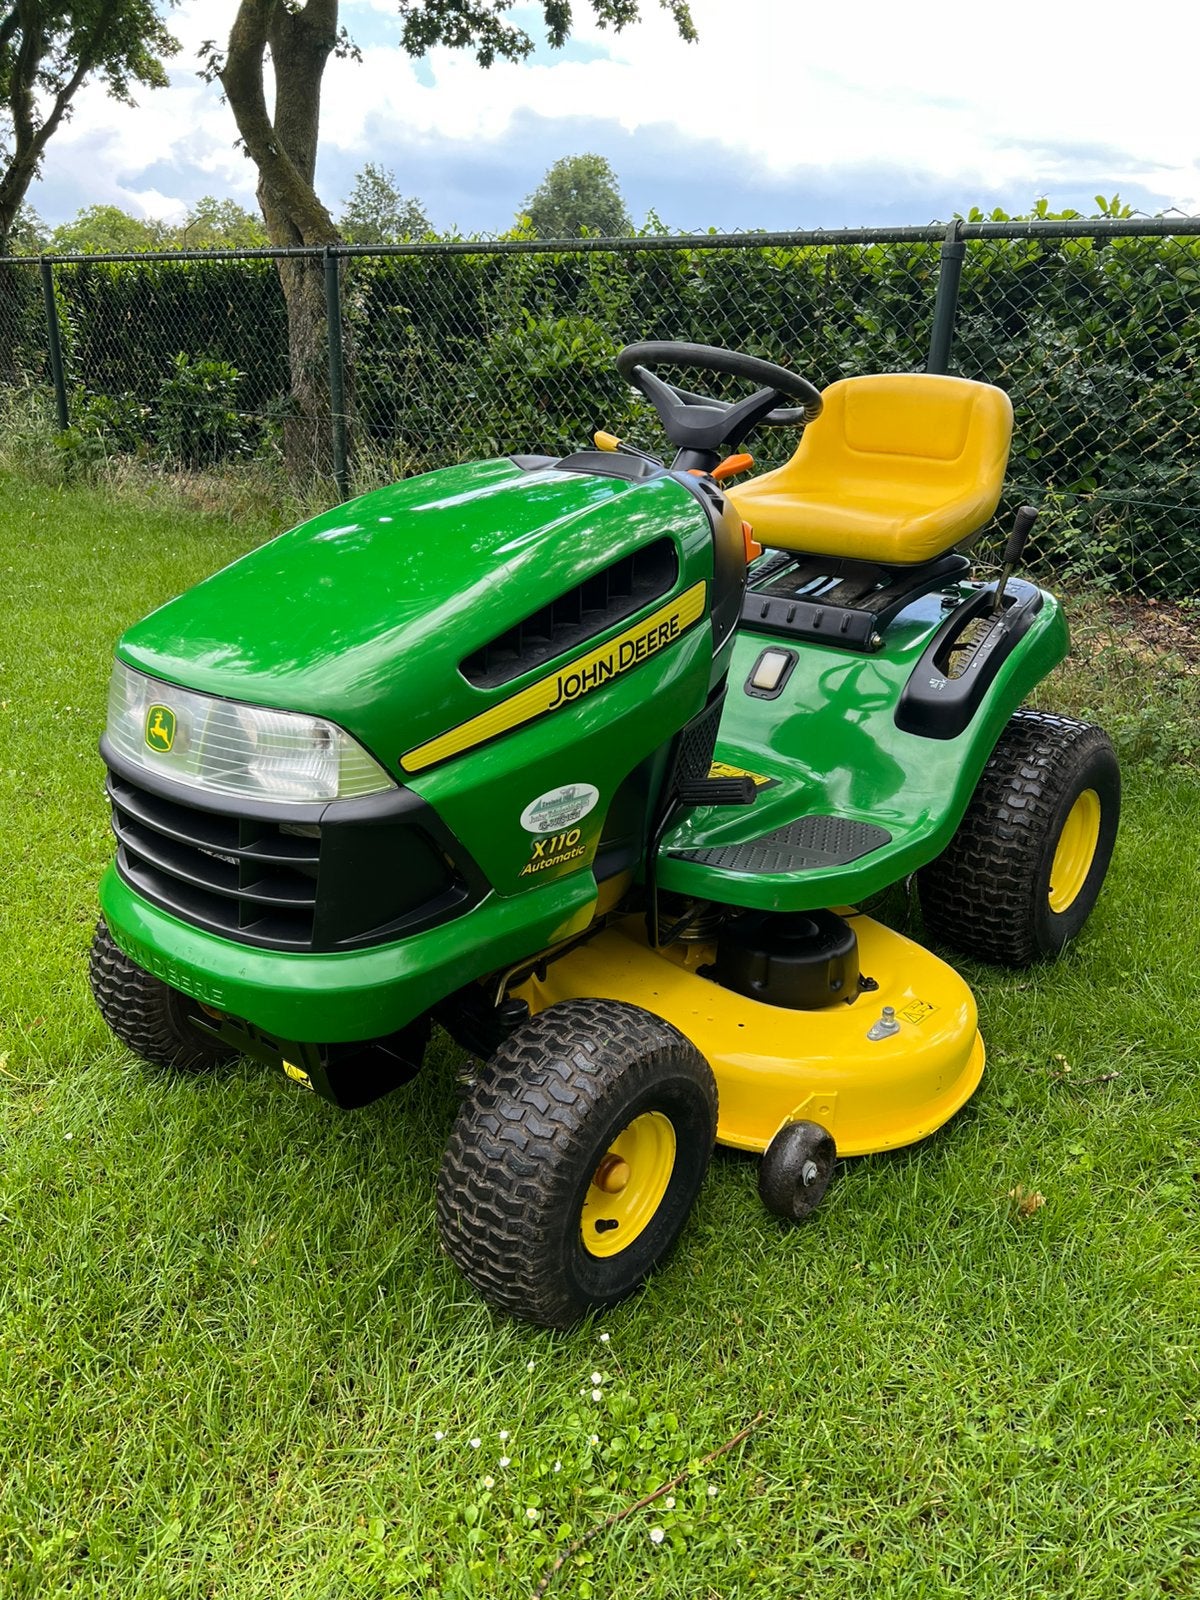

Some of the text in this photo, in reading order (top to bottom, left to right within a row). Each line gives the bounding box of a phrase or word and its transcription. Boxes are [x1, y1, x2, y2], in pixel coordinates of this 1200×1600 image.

[549, 613, 681, 709] JOHN DEERE
[520, 844, 586, 877] Automatic
[532, 828, 581, 860] X110
